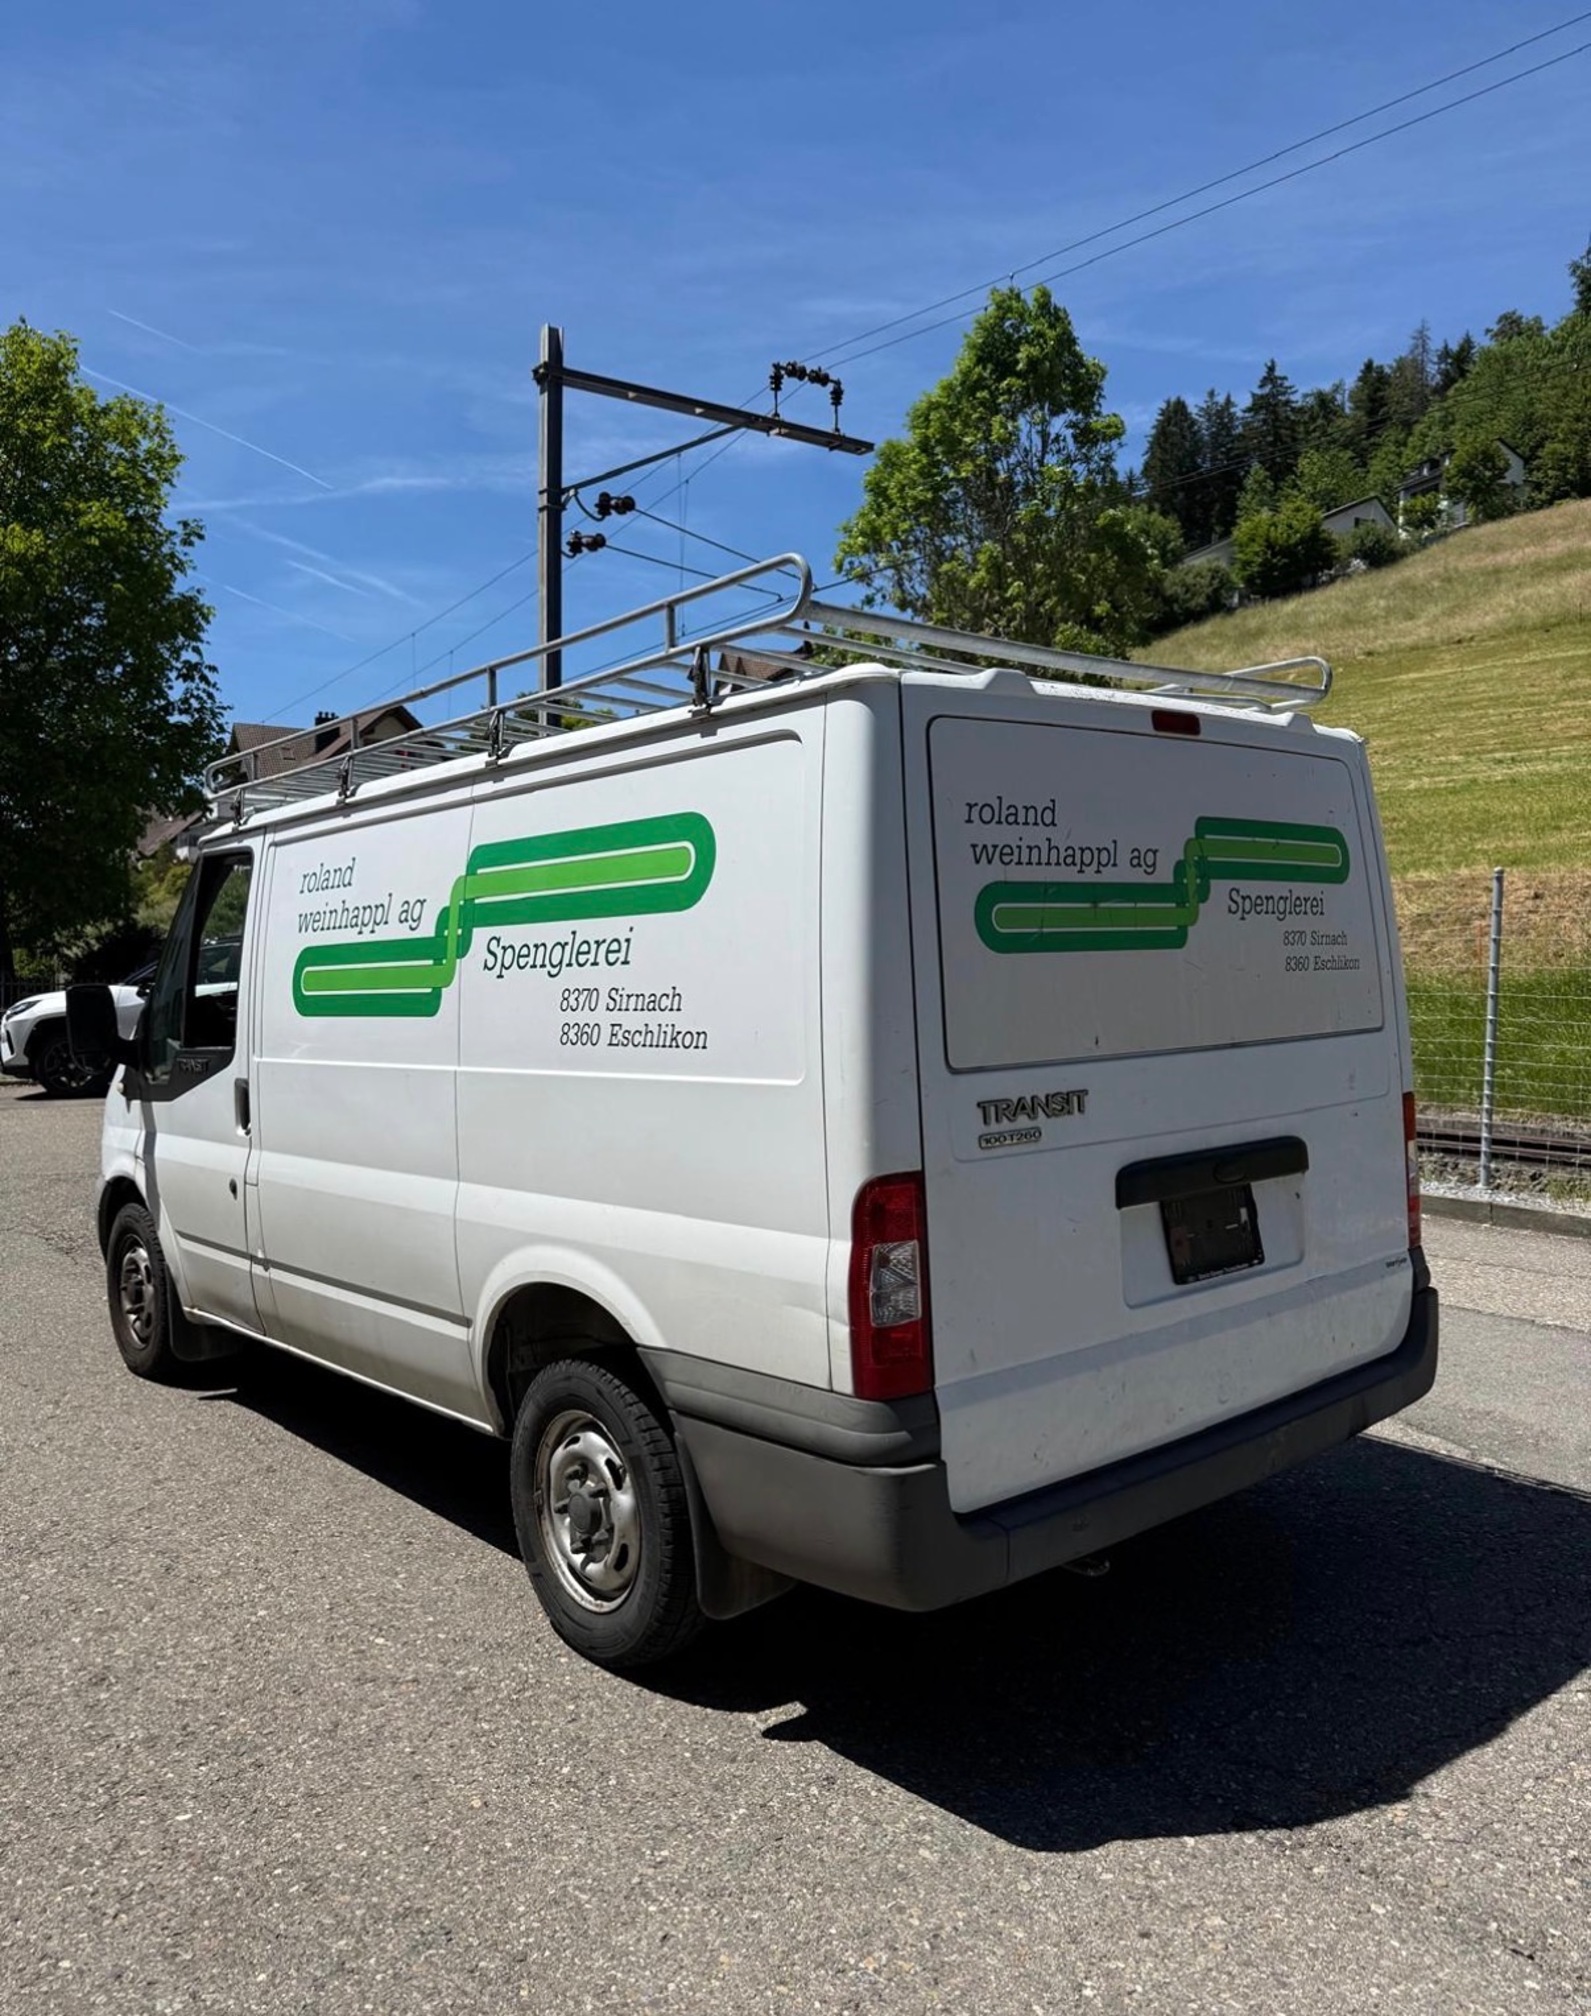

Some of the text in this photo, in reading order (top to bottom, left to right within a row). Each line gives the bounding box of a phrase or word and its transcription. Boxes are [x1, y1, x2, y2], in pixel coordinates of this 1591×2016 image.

[963, 796, 1058, 828] roland
[970, 837, 1159, 876] weinhappl ag
[299, 857, 356, 894] roland
[297, 893, 427, 935] weinhappl ag
[1227, 887, 1325, 921] Spenglerei
[482, 926, 634, 979] Spenglerei
[1283, 930, 1348, 946] 8370 Sirnach
[1285, 956, 1360, 972] 8360 Eschlikon
[559, 986, 683, 1012] 8370 Sirnach
[559, 1022, 709, 1050] 8360 Eschlikon
[976, 1089, 1089, 1126] TRANSIT
